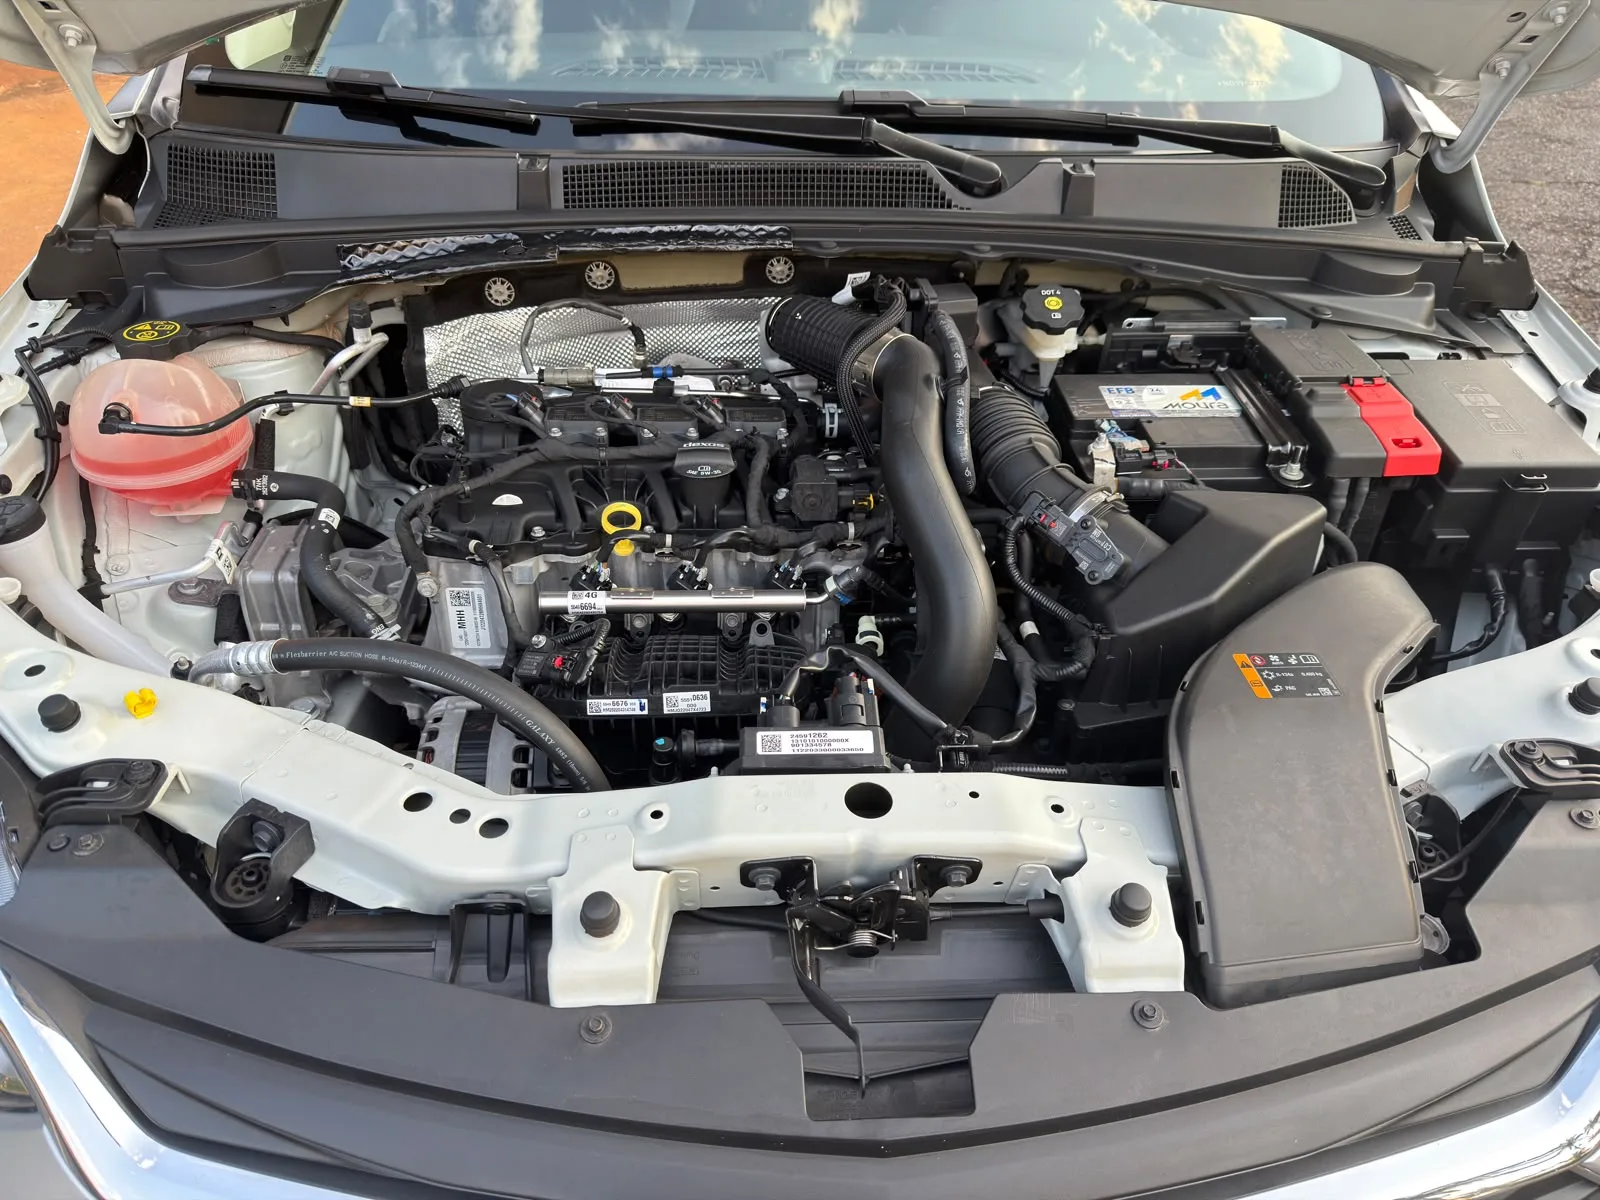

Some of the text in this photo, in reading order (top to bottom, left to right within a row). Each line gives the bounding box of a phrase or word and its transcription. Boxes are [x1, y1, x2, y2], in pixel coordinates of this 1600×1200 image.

[1107, 387, 1135, 395] EFB
[456, 610, 467, 629] MHH
[525, 719, 556, 746] GALAXY
